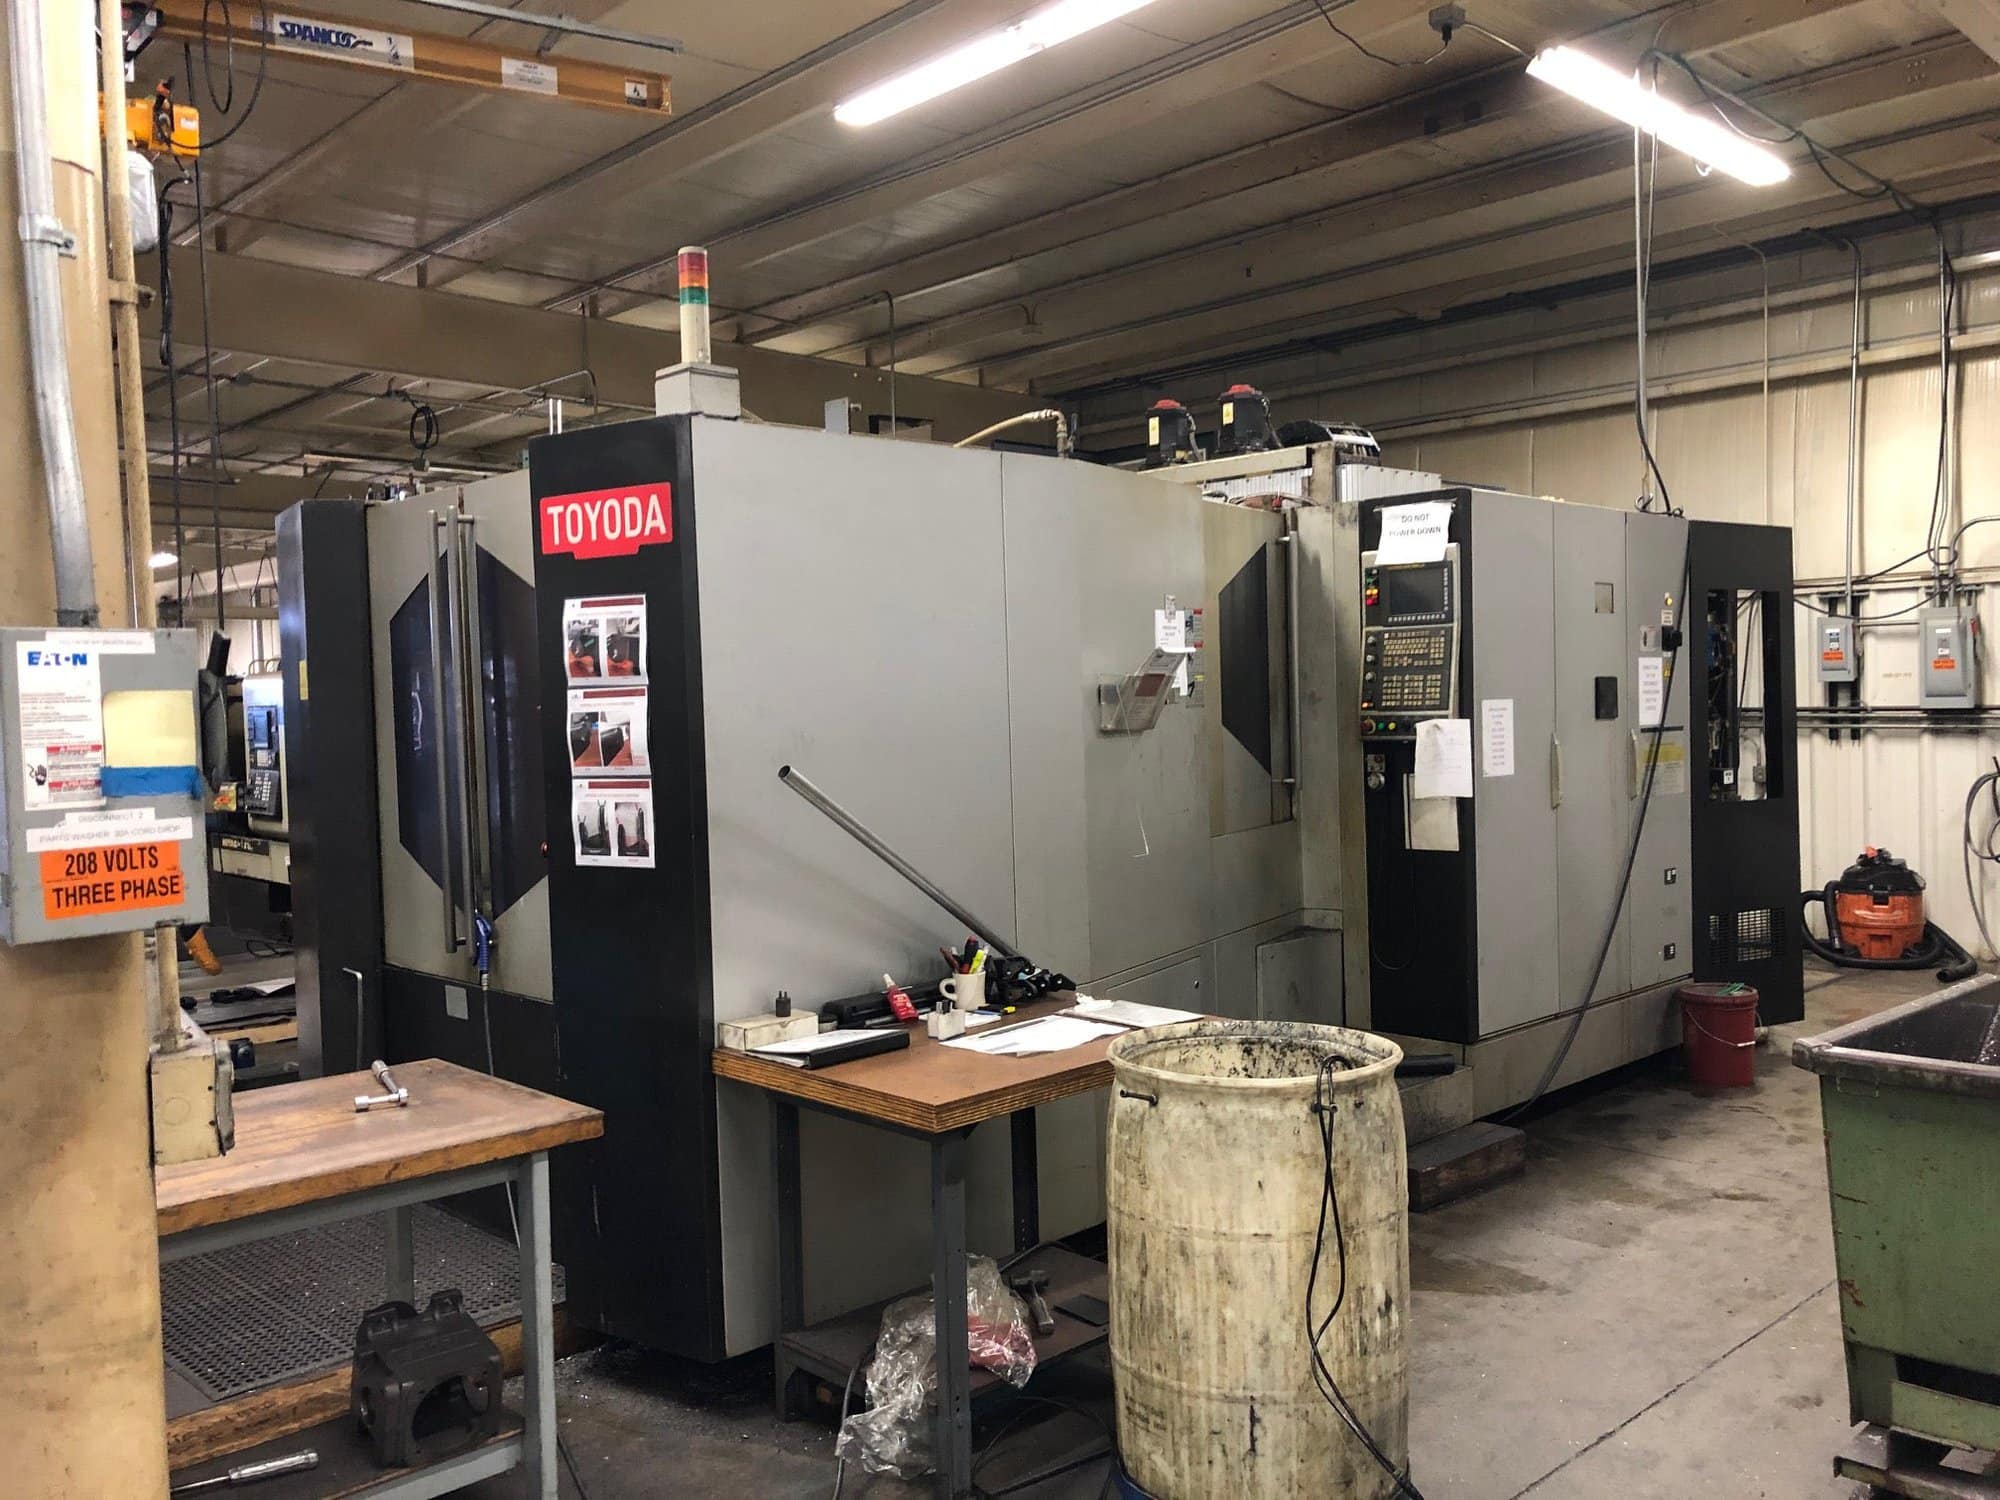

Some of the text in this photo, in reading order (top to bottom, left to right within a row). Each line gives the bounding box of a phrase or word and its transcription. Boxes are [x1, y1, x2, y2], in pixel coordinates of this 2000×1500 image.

[547, 493, 667, 546] TOYODA
[1401, 513, 1429, 524] DO NOT
[1416, 526, 1441, 536] DOWN
[65, 846, 159, 877] 208 VOLTS
[52, 875, 181, 909] THREE PHASE
